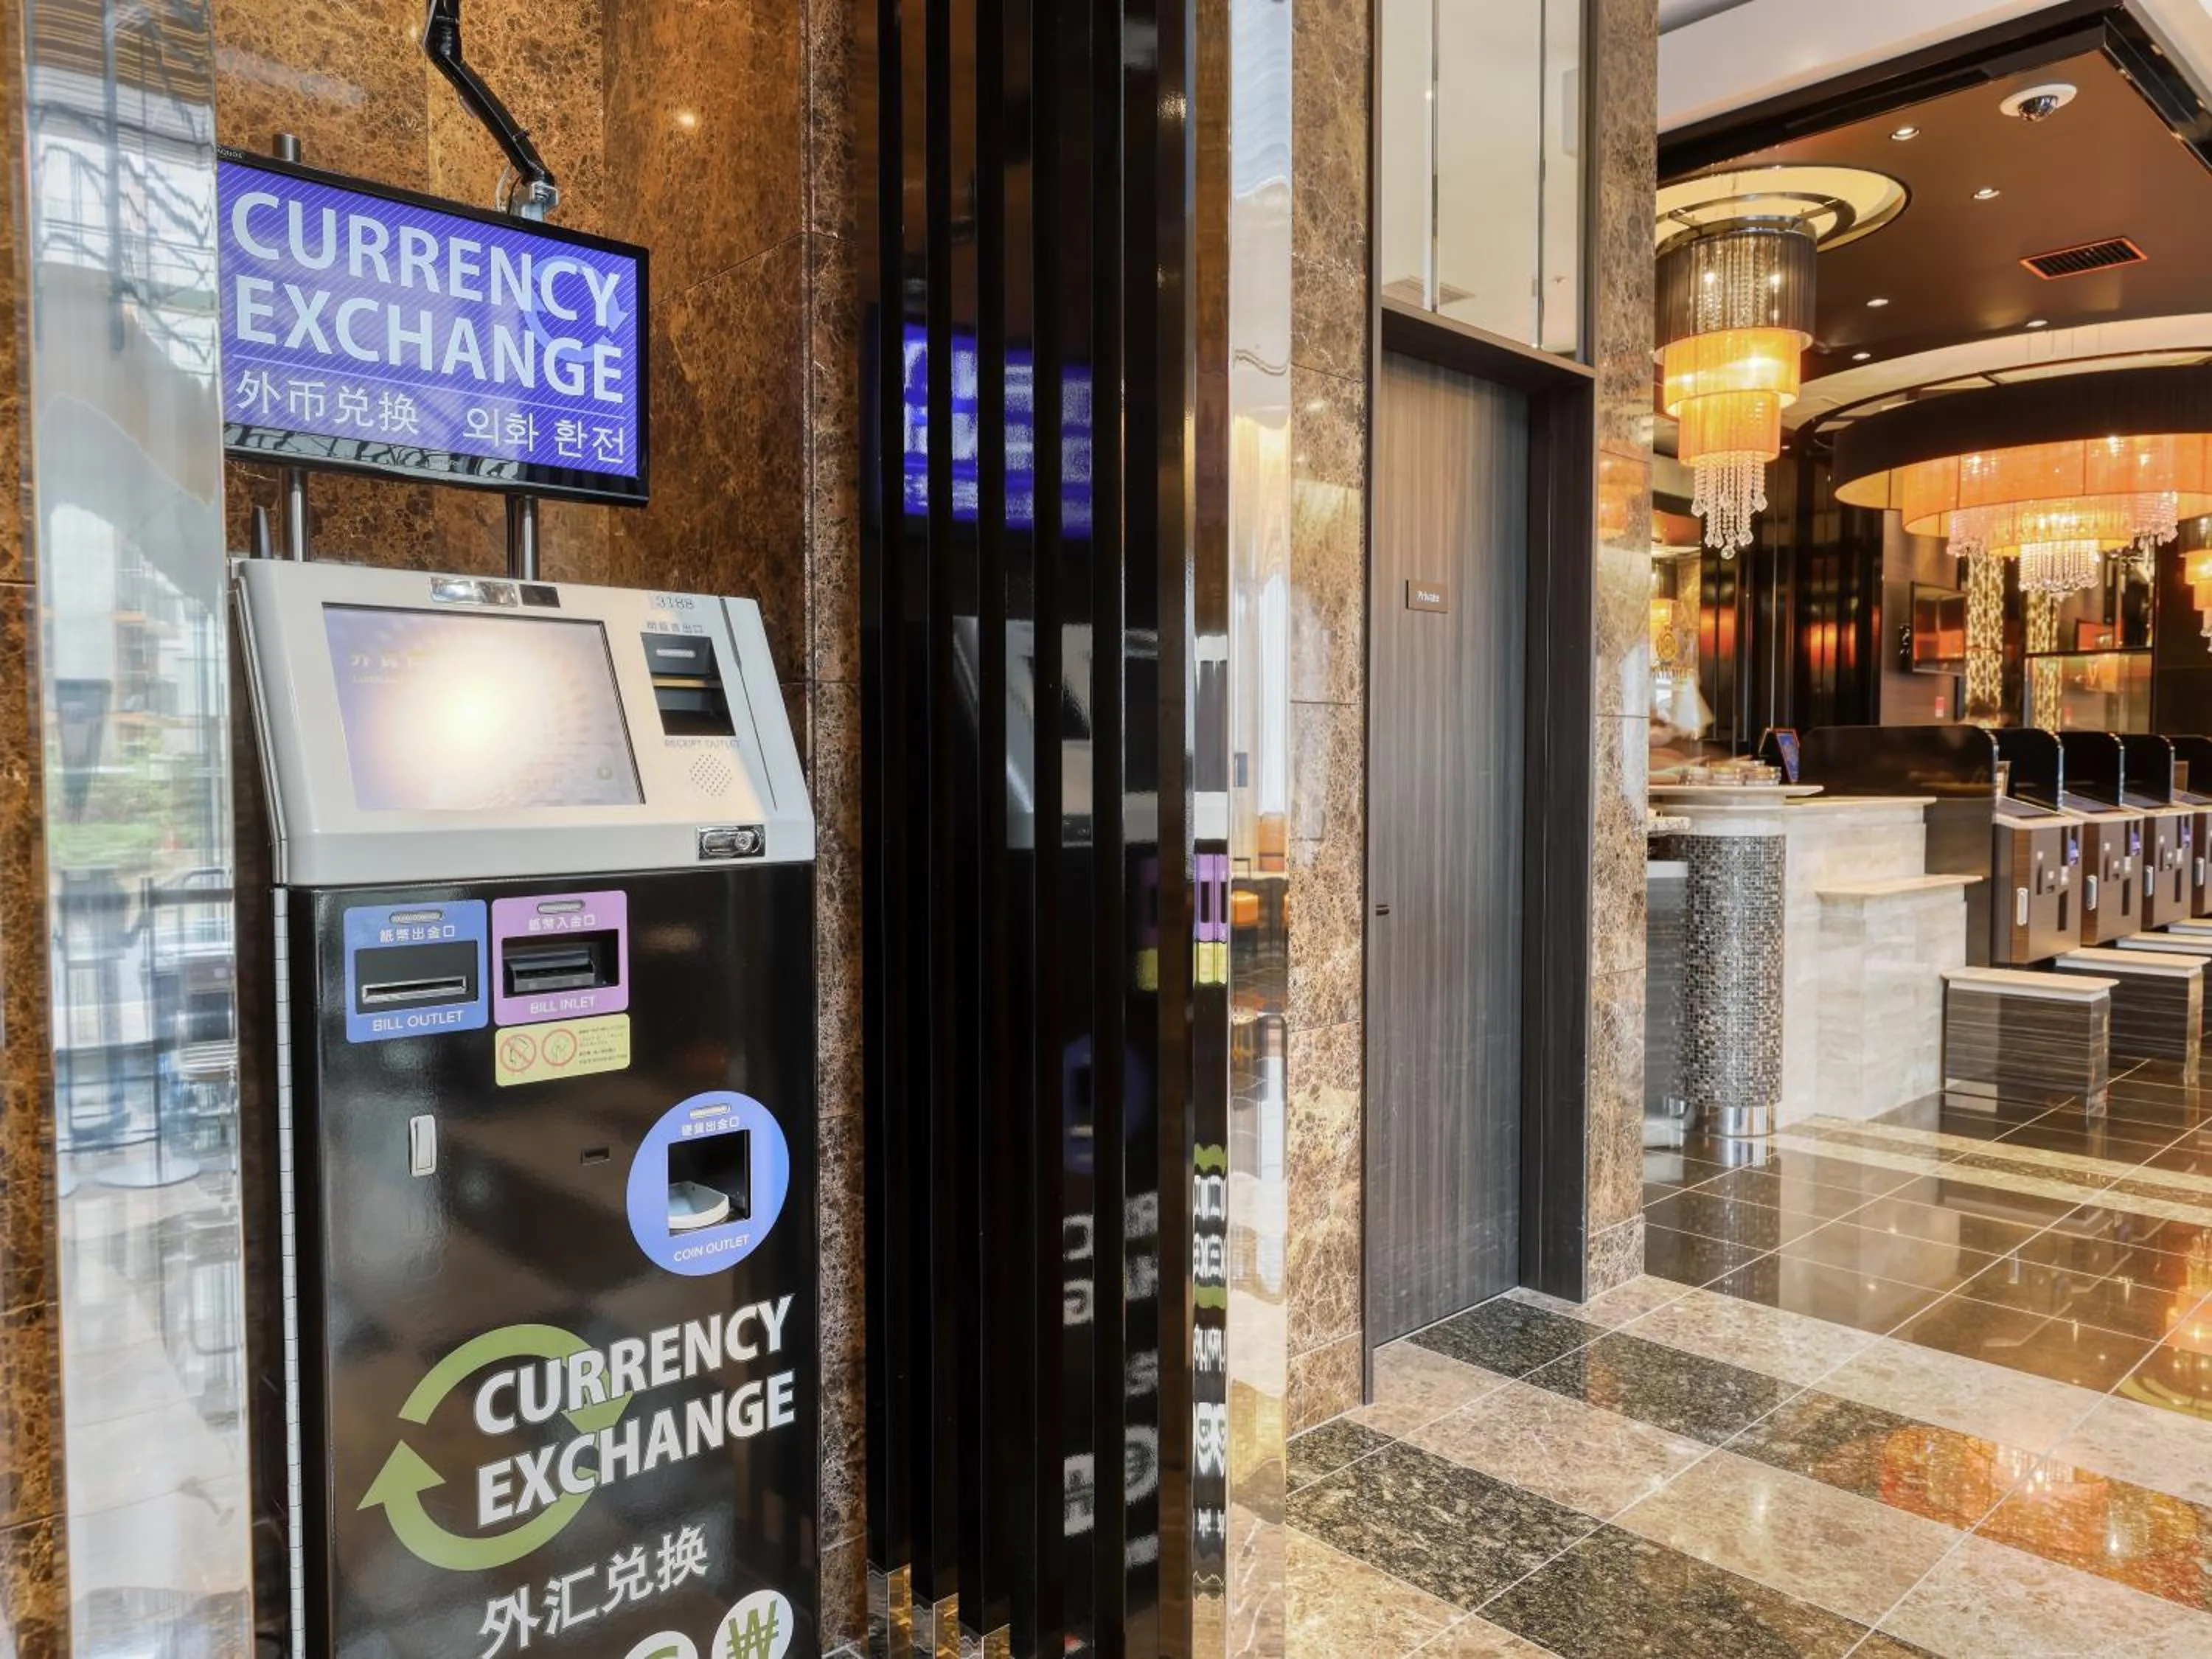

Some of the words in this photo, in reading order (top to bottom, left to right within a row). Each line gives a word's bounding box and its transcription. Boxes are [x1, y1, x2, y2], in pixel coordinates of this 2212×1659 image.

[231, 192, 621, 327] CURRENCY
[235, 274, 624, 404] EXCHANGE
[235, 369, 420, 435] 外币兑换
[462, 406, 539, 452] 외화
[553, 419, 625, 463] 환전
[372, 1018, 403, 1032] BILL
[407, 1010, 464, 1027] OUTLET
[529, 1001, 558, 1015] BILL
[560, 995, 595, 1010] INLET
[673, 1246, 703, 1262] COIN
[706, 1234, 751, 1254] OUTLET
[476, 1295, 793, 1435] CURRENCY
[478, 1371, 795, 1526] EXCHANGE
[480, 1524, 708, 1659] 外汇兑换
